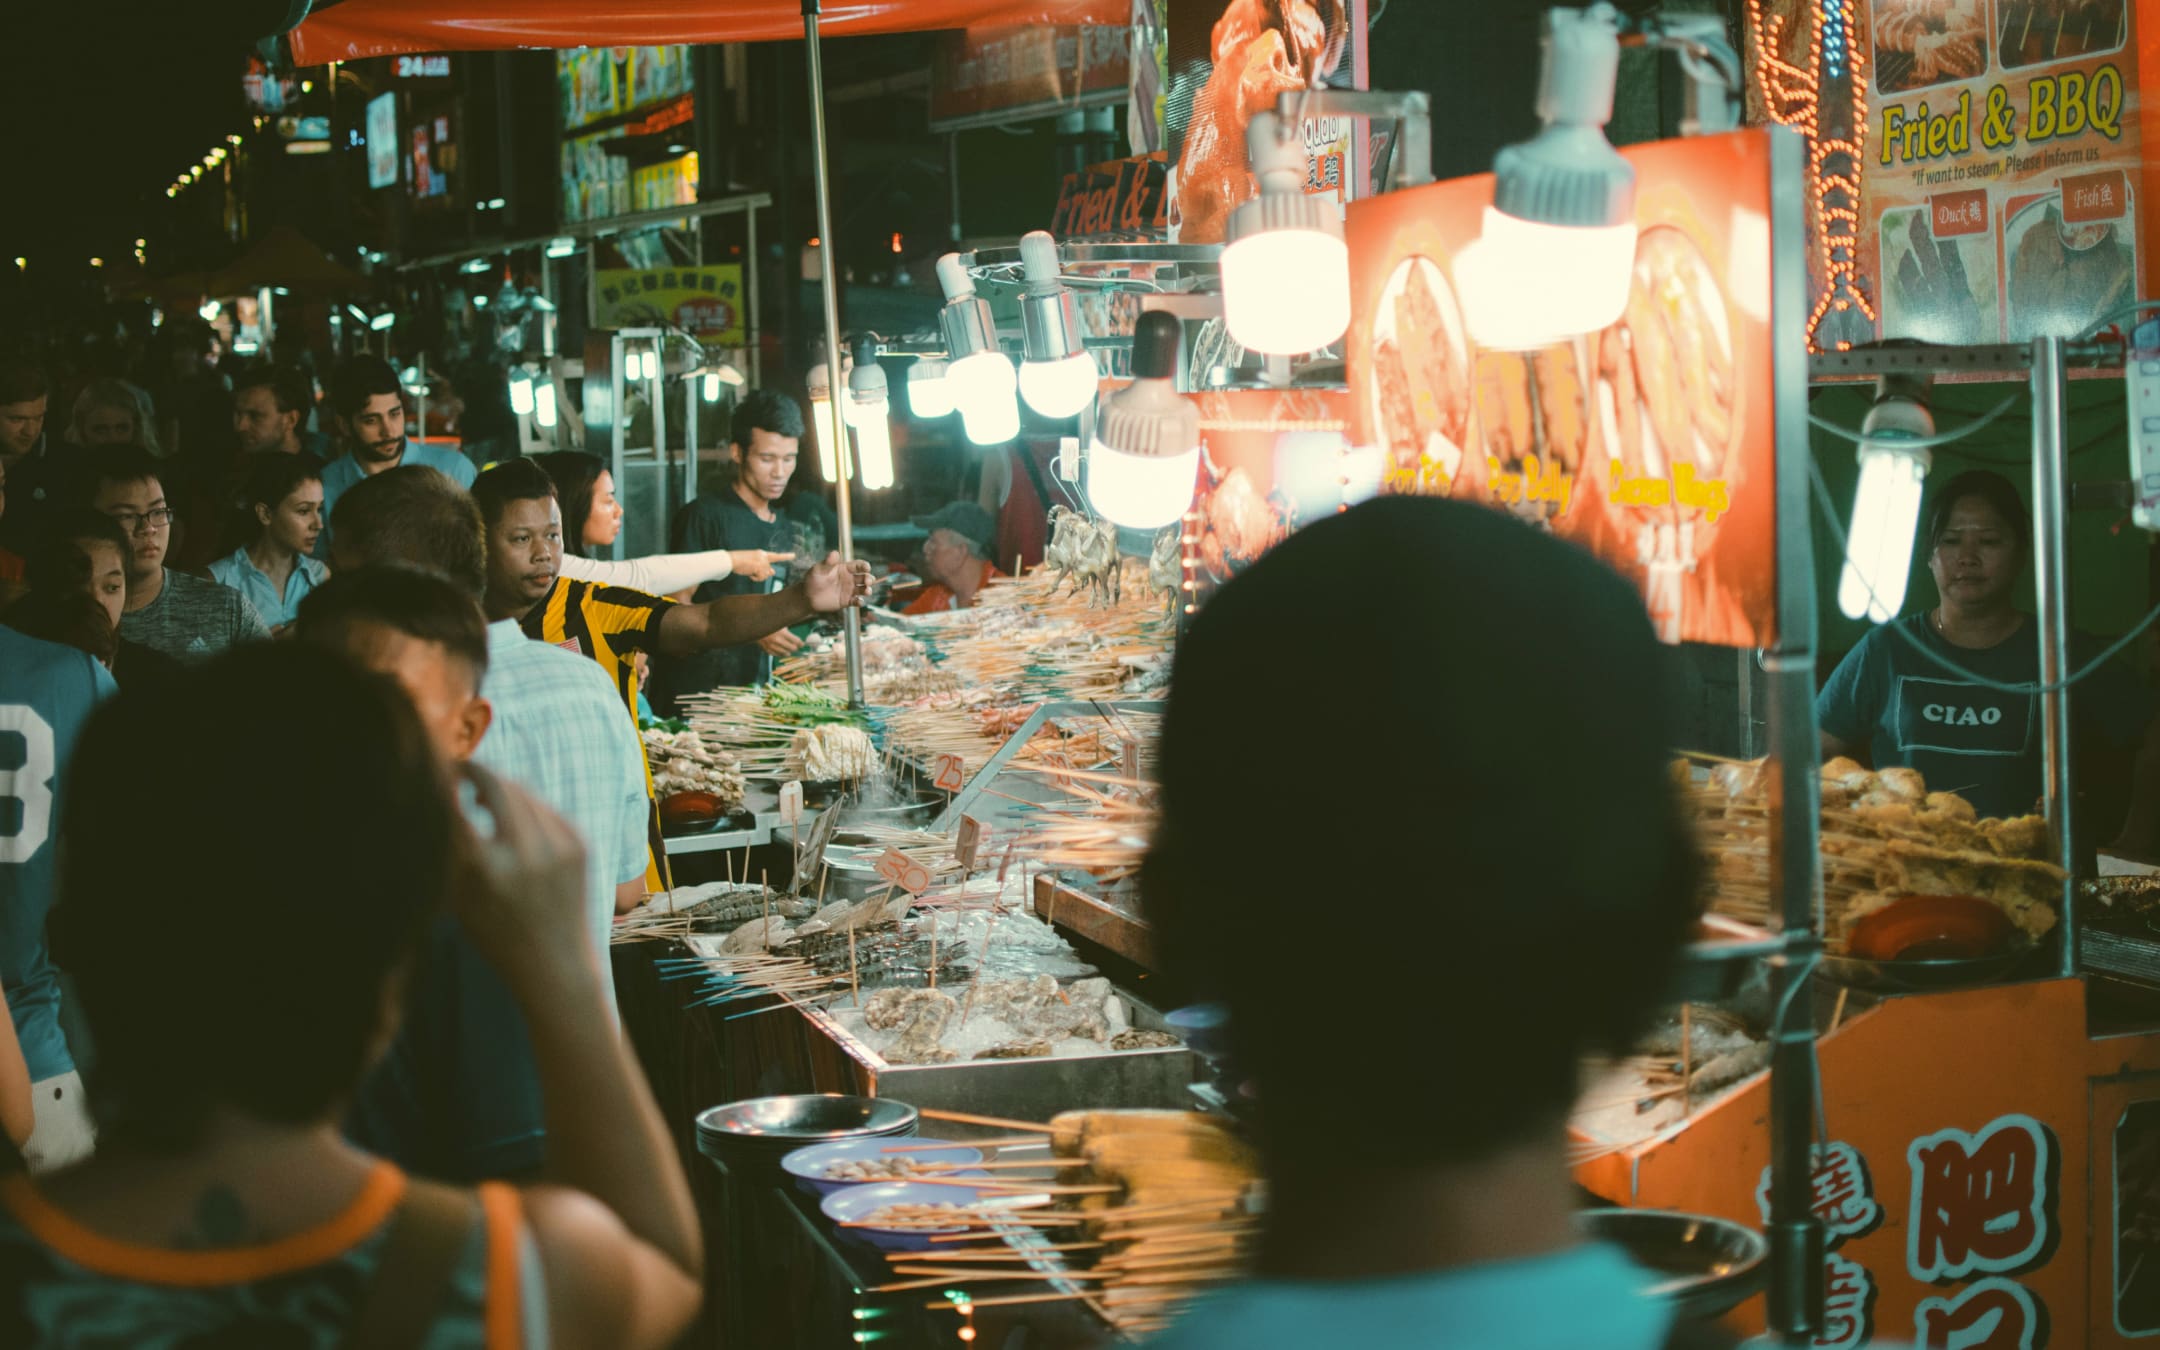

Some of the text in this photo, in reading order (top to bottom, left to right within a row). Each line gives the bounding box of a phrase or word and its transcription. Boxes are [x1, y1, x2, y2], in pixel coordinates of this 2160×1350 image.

[1879, 63, 2124, 165] Fried & BBQ
[1926, 169, 1952, 185] want
[1954, 165, 1965, 180] to
[2005, 154, 2041, 175] Please
[2086, 147, 2100, 162] us
[1050, 165, 1123, 236] Fried
[1120, 160, 1150, 230] &
[1938, 200, 1969, 226] Duck
[2074, 184, 2099, 208] Fish
[1922, 703, 2002, 726] CIAO
[936, 754, 964, 789] 25
[882, 852, 930, 892] 30
